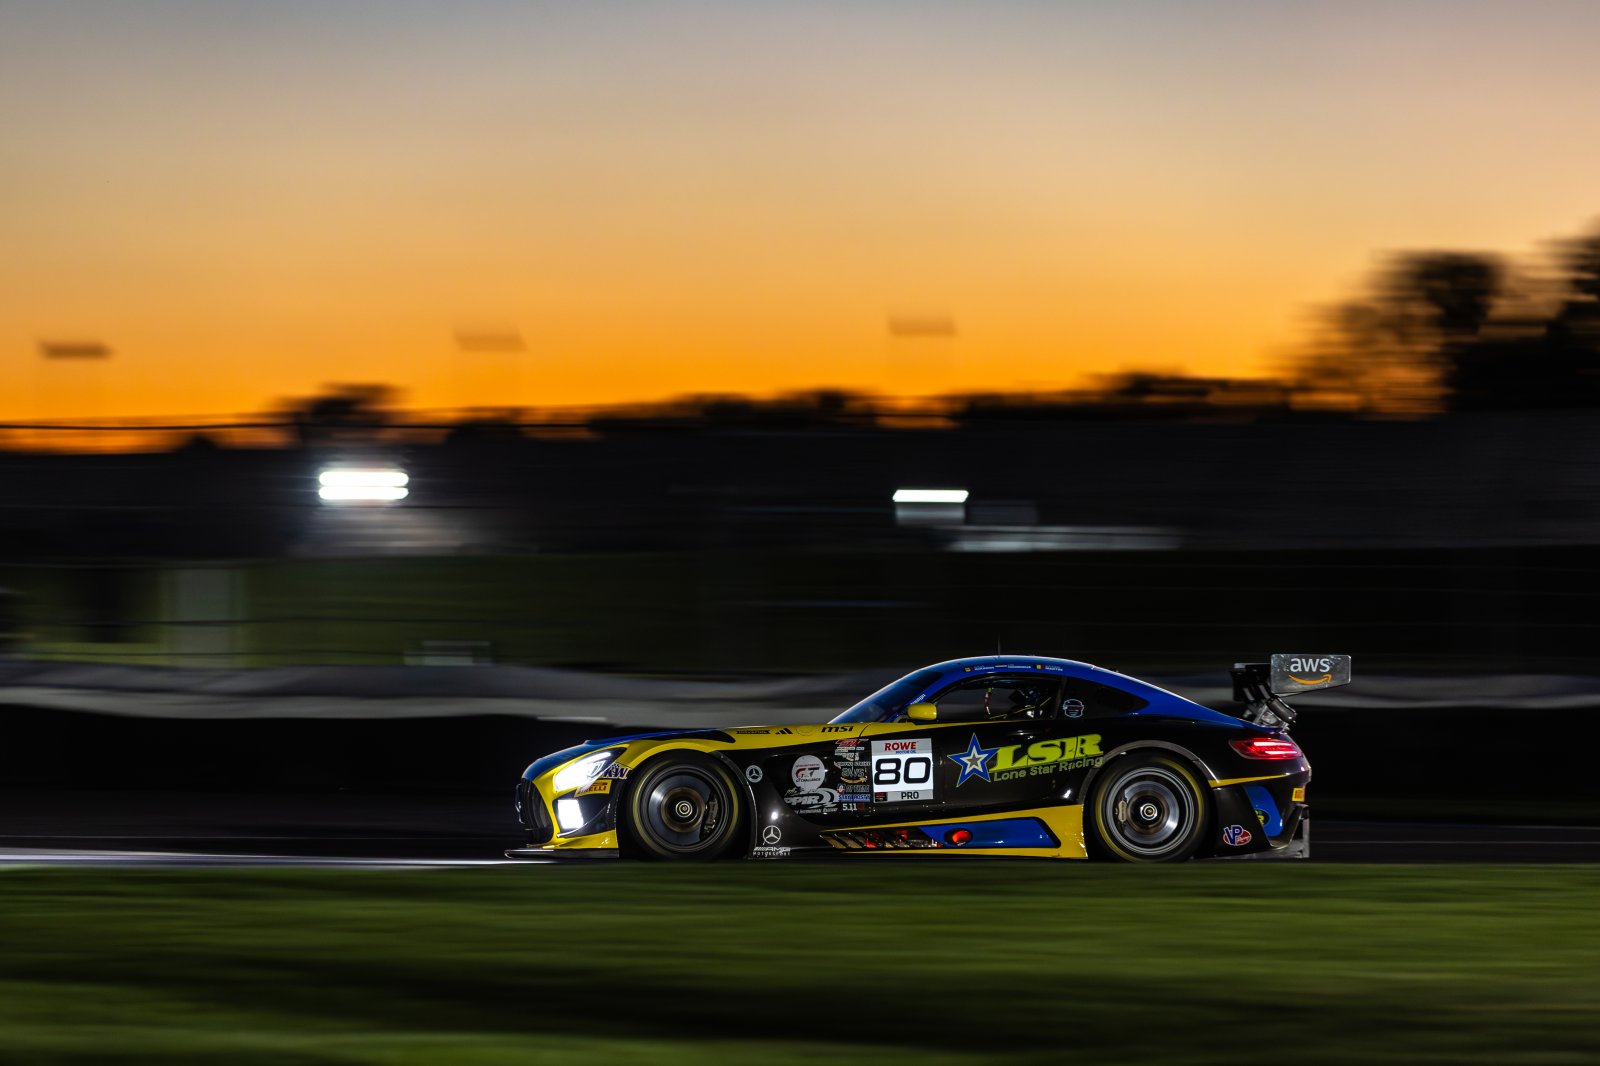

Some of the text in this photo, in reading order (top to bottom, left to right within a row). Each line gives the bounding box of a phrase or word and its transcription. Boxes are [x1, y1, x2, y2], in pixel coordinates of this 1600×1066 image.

[1290, 658, 1330, 672] aws
[884, 742, 917, 751] ROWE
[988, 733, 1103, 773] LSR
[603, 766, 629, 779] KW
[874, 757, 931, 785] 80
[994, 755, 1104, 782] Lone Star Racing
[901, 791, 919, 799] PRO
[842, 803, 858, 811] 5.11
[1224, 825, 1244, 845] VP
